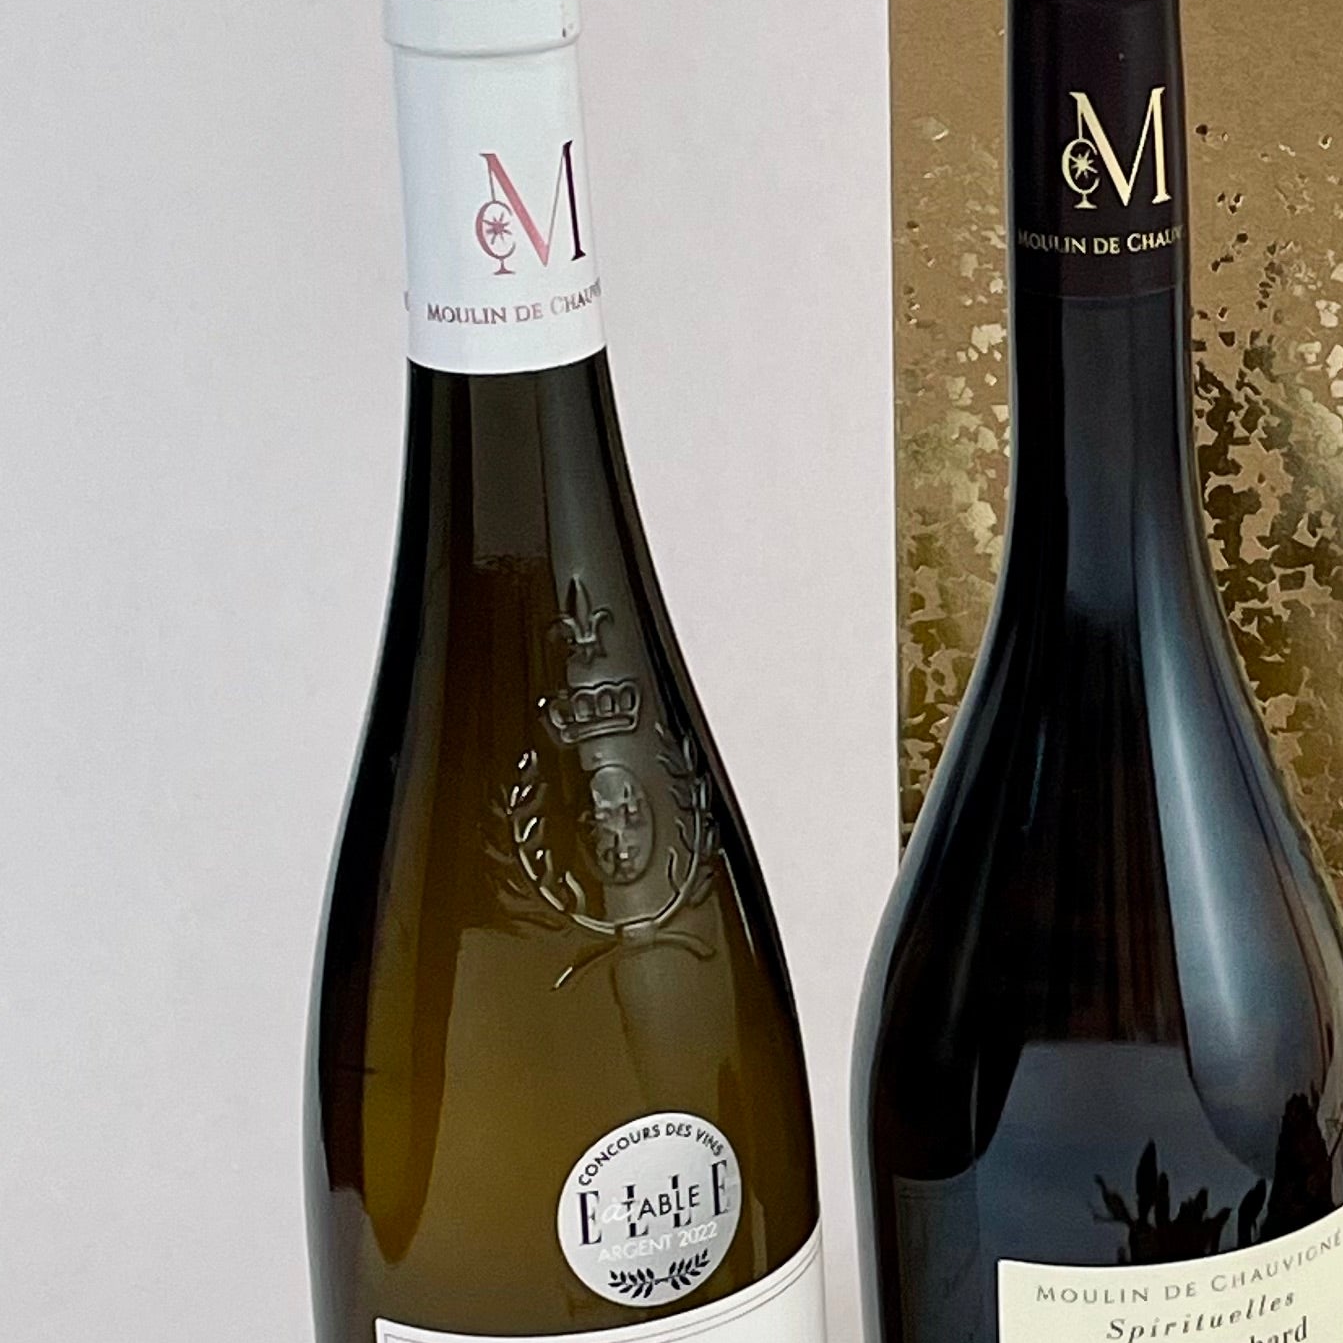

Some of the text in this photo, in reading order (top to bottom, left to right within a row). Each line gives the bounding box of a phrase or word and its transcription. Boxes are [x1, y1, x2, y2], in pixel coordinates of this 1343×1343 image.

[1018, 228, 1087, 255] MOULIN
[1093, 237, 1121, 255] DE
[427, 302, 508, 325] MOULIN
[515, 302, 544, 323] DE
[578, 1122, 724, 1187] CONCOURS DES VINS
[621, 1184, 700, 1221] TABLE
[597, 1221, 718, 1263] ARGENT 2022
[1036, 1228, 1342, 1305] MOULIN DE CHAUVIGNÉ
